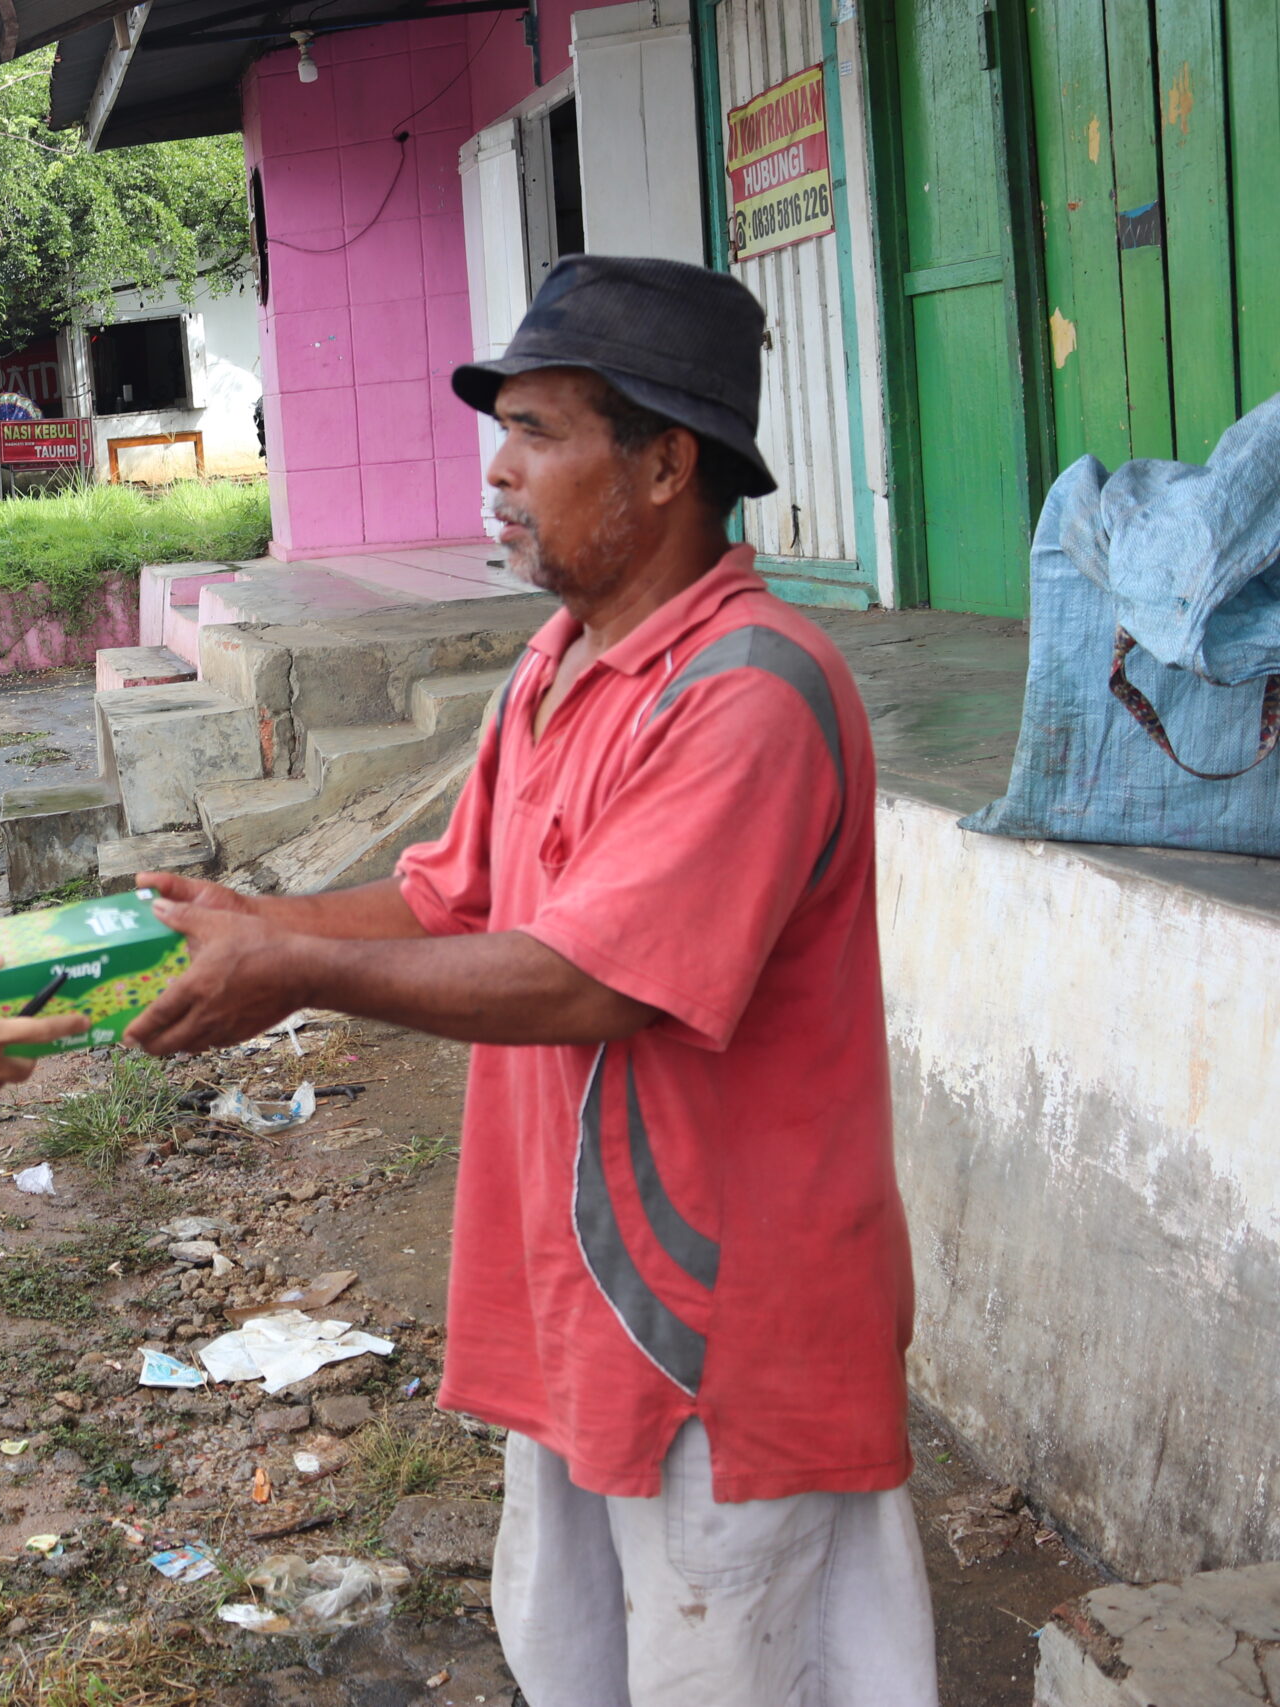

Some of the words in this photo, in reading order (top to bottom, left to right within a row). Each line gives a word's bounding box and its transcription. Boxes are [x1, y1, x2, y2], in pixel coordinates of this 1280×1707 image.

[743, 143, 805, 197] HUBUNGI
[752, 203, 776, 241] 0838
[776, 192, 802, 232] 5816
[803, 183, 829, 223] 226
[3, 424, 31, 440] NASI
[34, 423, 76, 439] KEBULI
[34, 444, 77, 458] TAUHID
